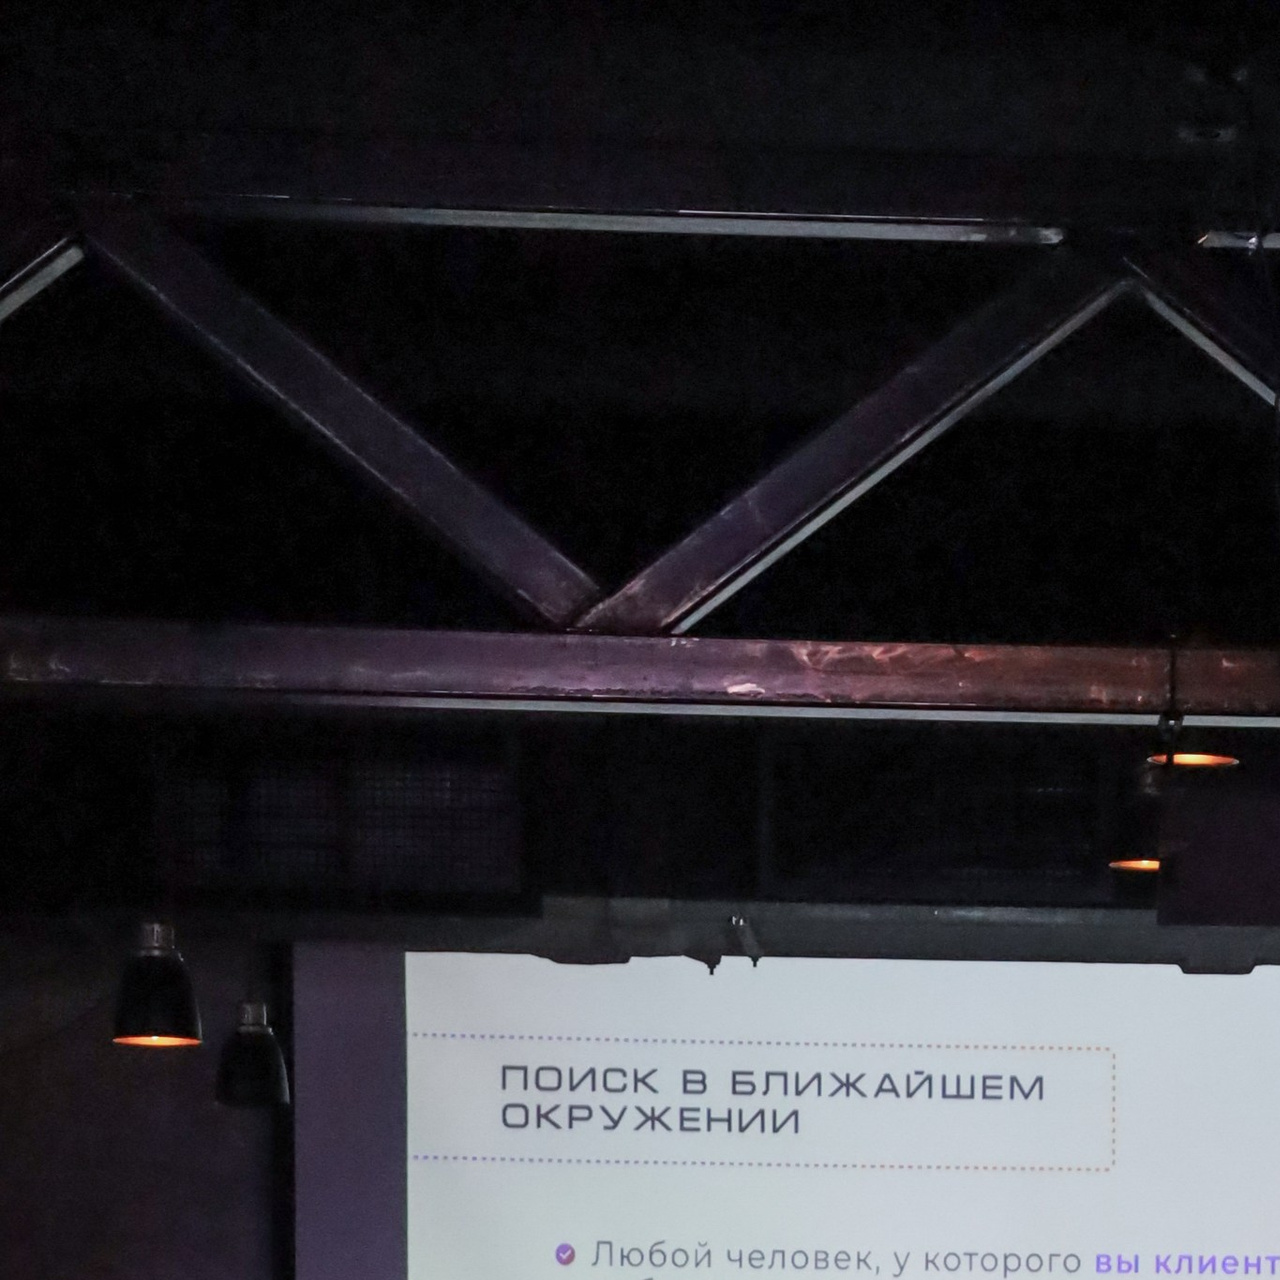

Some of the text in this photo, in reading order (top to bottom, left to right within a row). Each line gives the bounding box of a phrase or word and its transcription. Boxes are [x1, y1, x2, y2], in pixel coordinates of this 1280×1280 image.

[501, 1064, 1045, 1102] ПОИСК В БЛИЖАЙШЕМ
[501, 1102, 801, 1135] ОКРУЖЕНИИ
[590, 1239, 713, 1270] Любой
[725, 1248, 881, 1276] человек,
[891, 1250, 911, 1279] у
[923, 1251, 1082, 1280] которого
[1094, 1252, 1140, 1275] вы
